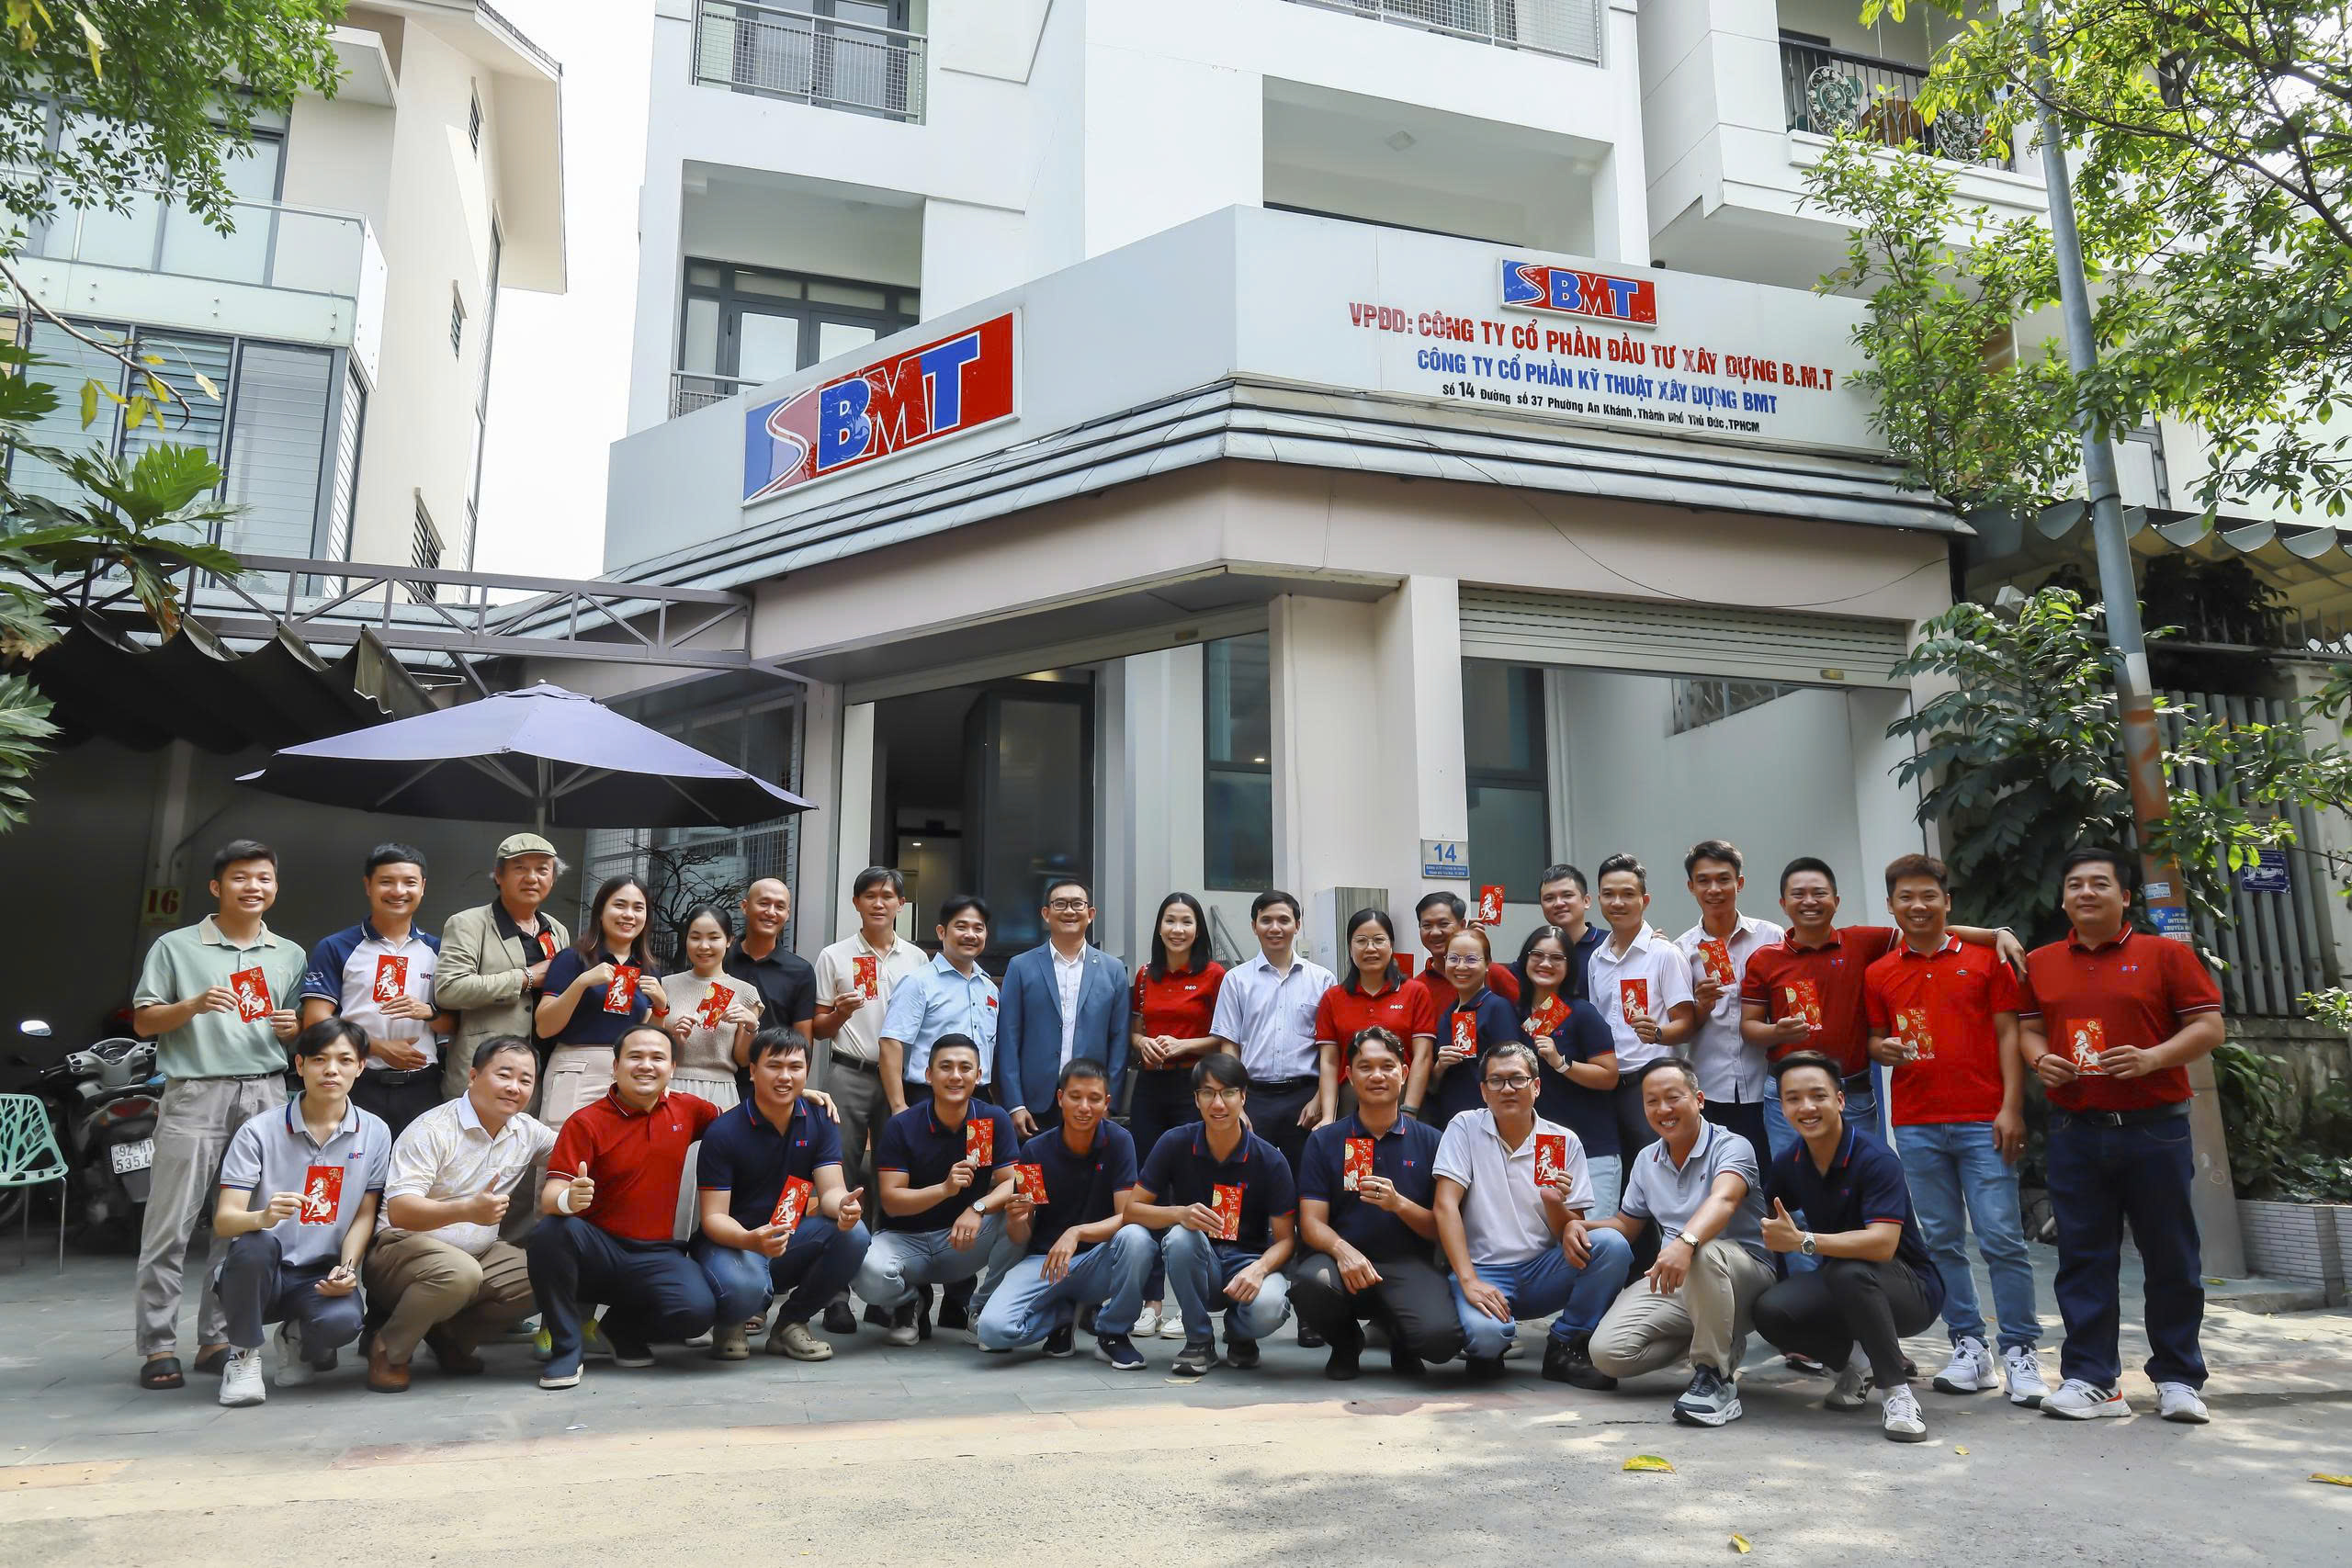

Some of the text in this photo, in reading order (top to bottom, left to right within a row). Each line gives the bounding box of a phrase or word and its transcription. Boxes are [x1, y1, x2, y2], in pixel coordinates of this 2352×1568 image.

[1349, 302, 1834, 391] VPĐD: CÔNG TY CỔ PHẦN ĐẦU TƯ XÂY DỰNG B.M.T
[1417, 346, 1778, 414] CÔNG TY CỔ PHẦN KỸ THUẬT XÂY DỰNG BMT
[1458, 381, 1476, 398] 14
[1480, 388, 1511, 405] Đường
[1531, 395, 1544, 407] 37
[1547, 397, 1584, 413] Phường
[1588, 401, 1600, 413] An
[1433, 842, 1457, 863] 14
[144, 888, 179, 915] 16
[116, 1154, 152, 1172] 535.4
